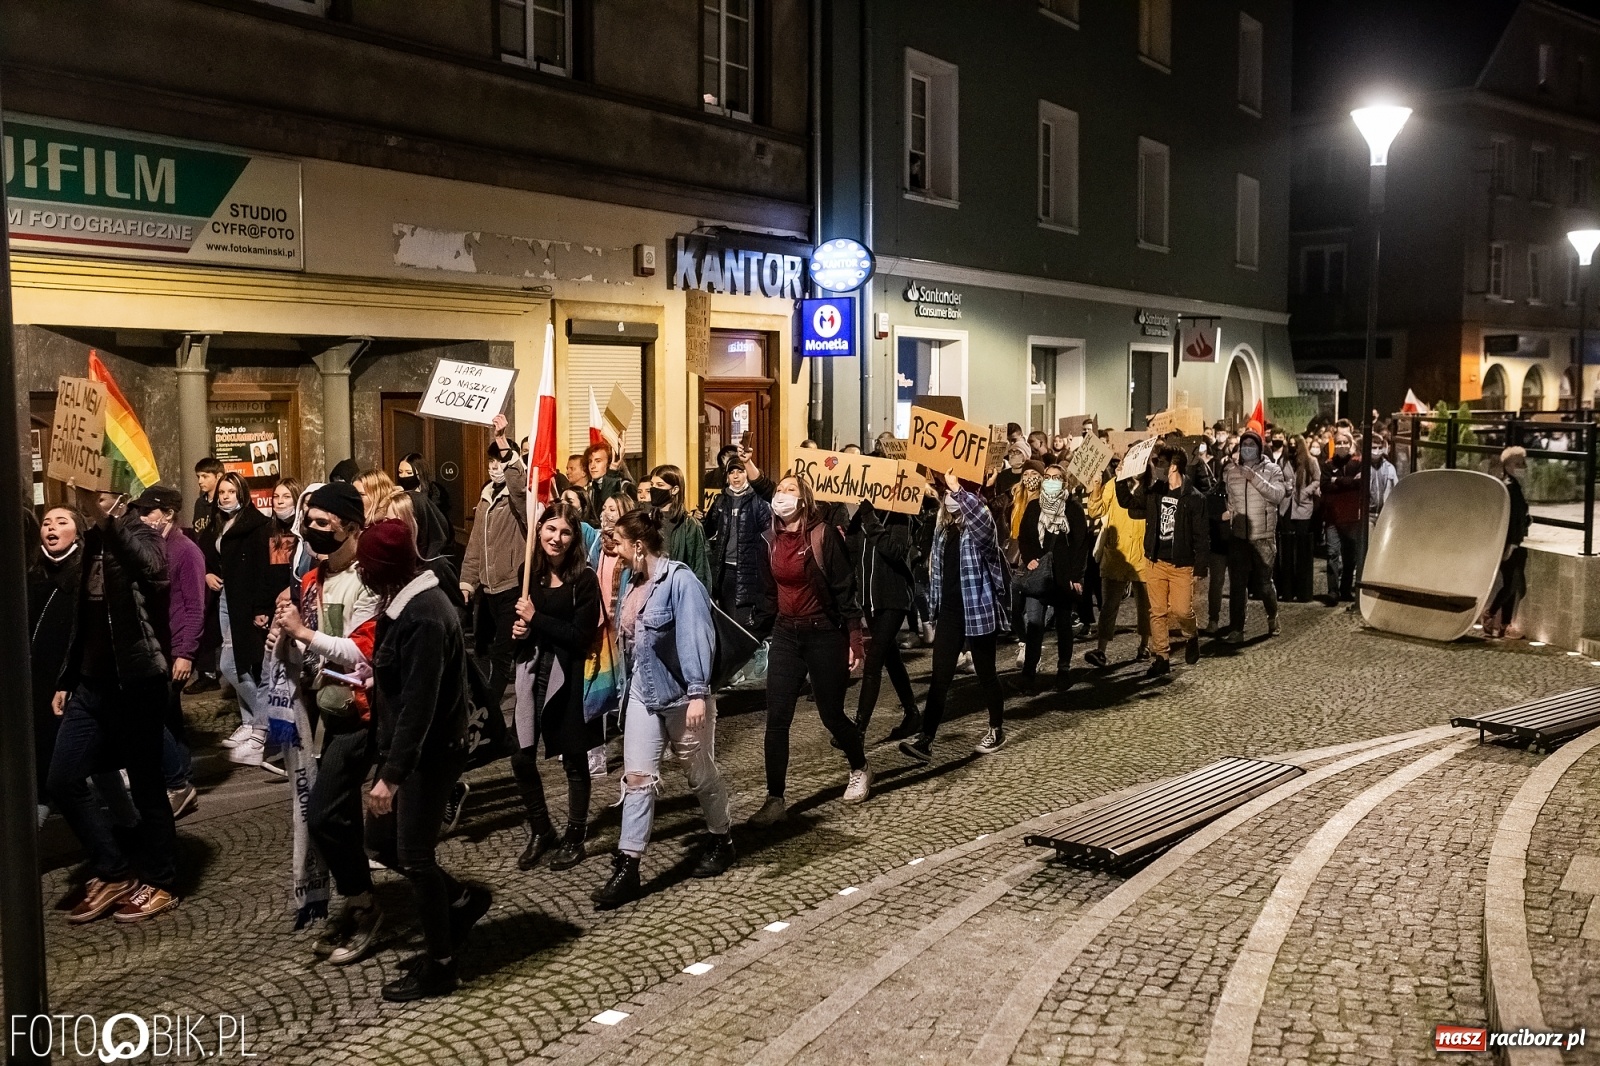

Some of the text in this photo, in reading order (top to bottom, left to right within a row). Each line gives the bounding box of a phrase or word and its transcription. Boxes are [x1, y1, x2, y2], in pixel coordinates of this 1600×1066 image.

[230, 203, 287, 223] STUDIO
[29, 210, 193, 241] FOTOGRAFICZNE
[211, 221, 295, 241] CYFR@FOTO
[206, 241, 296, 258] www.fotokaminski.pl
[675, 236, 802, 299] KANTOR
[919, 286, 963, 305] Santander
[919, 305, 962, 319] Consumer Bank
[805, 339, 849, 351] Monetia
[454, 364, 483, 377] WARA
[437, 376, 498, 394] OD NASZYCH
[59, 380, 103, 416] REAL MEN
[434, 389, 490, 413] KOBIET!
[215, 426, 237, 434] Zdjęcia
[912, 415, 939, 451] PiS
[952, 429, 988, 467] OFF
